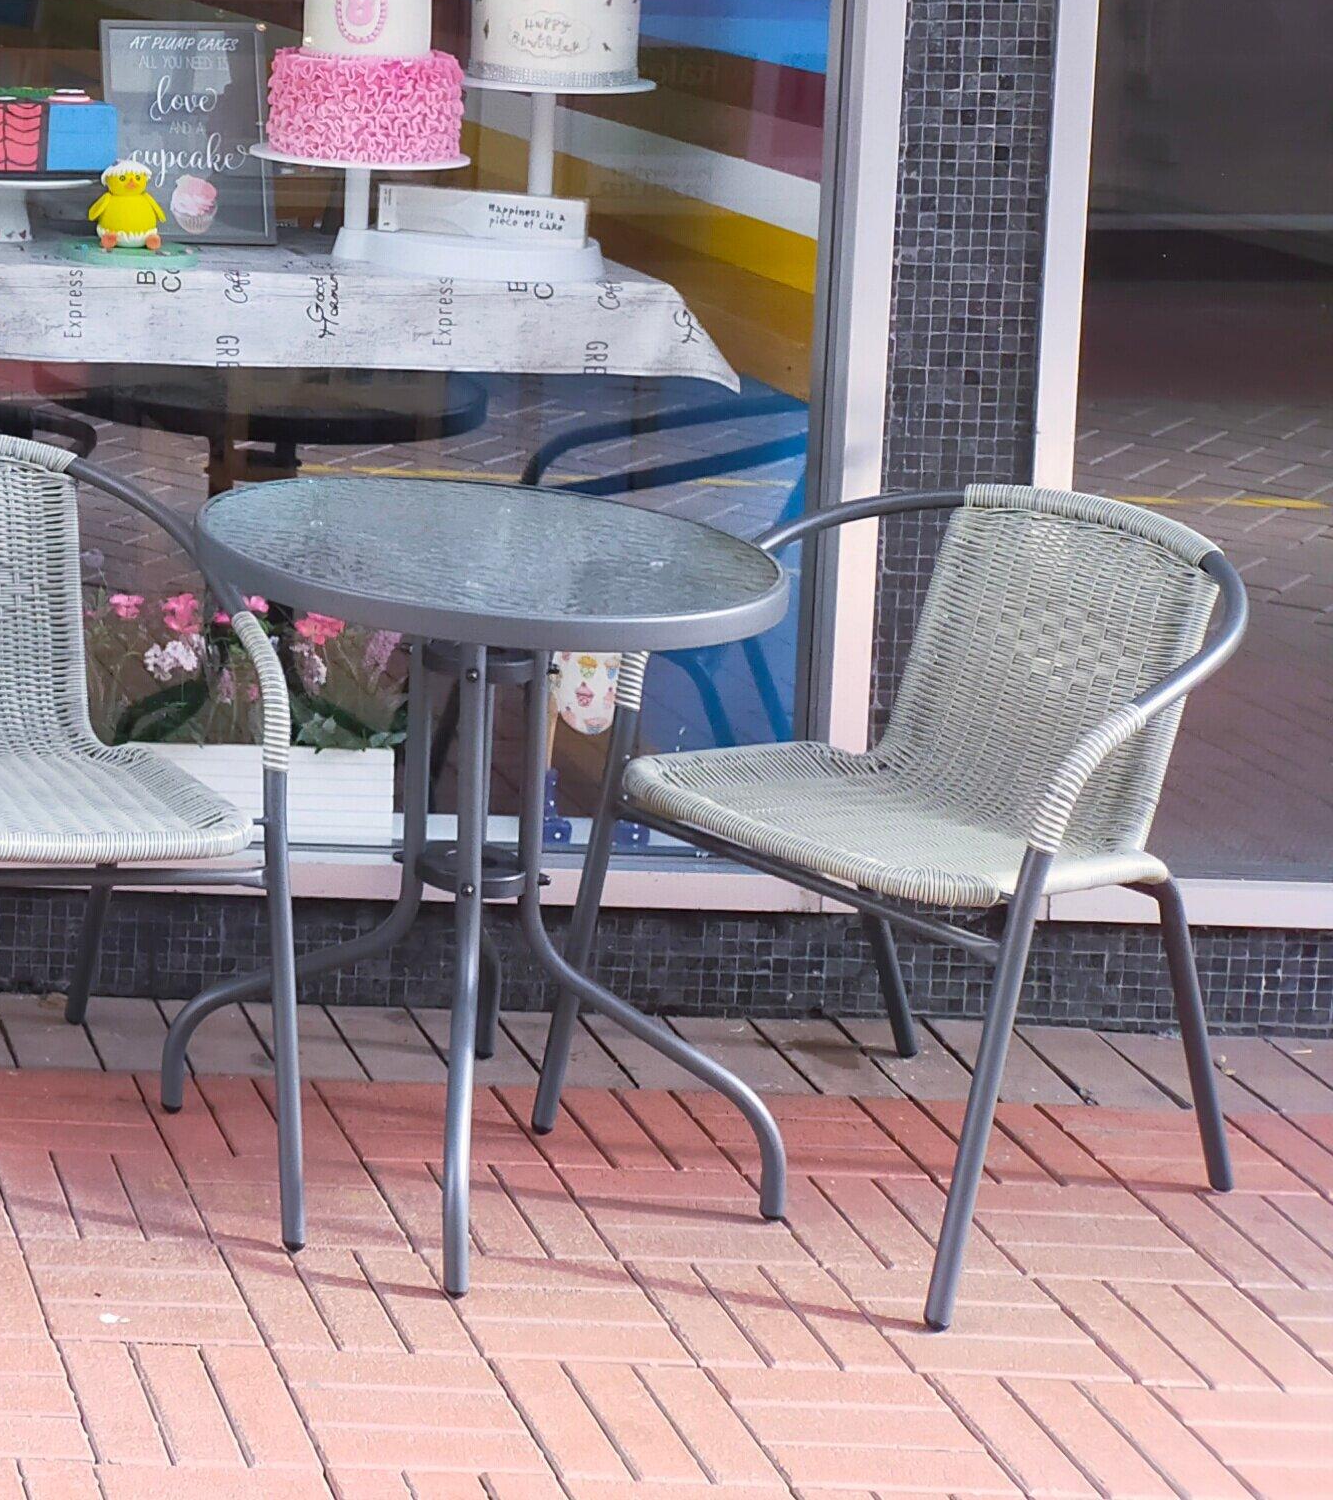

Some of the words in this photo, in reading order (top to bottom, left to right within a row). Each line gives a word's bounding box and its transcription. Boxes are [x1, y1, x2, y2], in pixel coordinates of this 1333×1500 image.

[129, 37, 150, 50] AT
[151, 37, 195, 51] PLUMP
[197, 37, 239, 51] CAKES
[137, 57, 159, 69] ALL
[161, 57, 184, 69] YOU
[149, 75, 218, 122] love
[169, 122, 192, 135] AND
[194, 122, 207, 136] A
[129, 133, 251, 188] cupcake
[488, 203, 541, 218] Happiness
[545, 209, 555, 220] is
[489, 216, 519, 228] piece
[523, 218, 534, 228] of
[539, 221, 563, 232] cake
[63, 269, 86, 339] Express
[432, 276, 455, 346] Express
